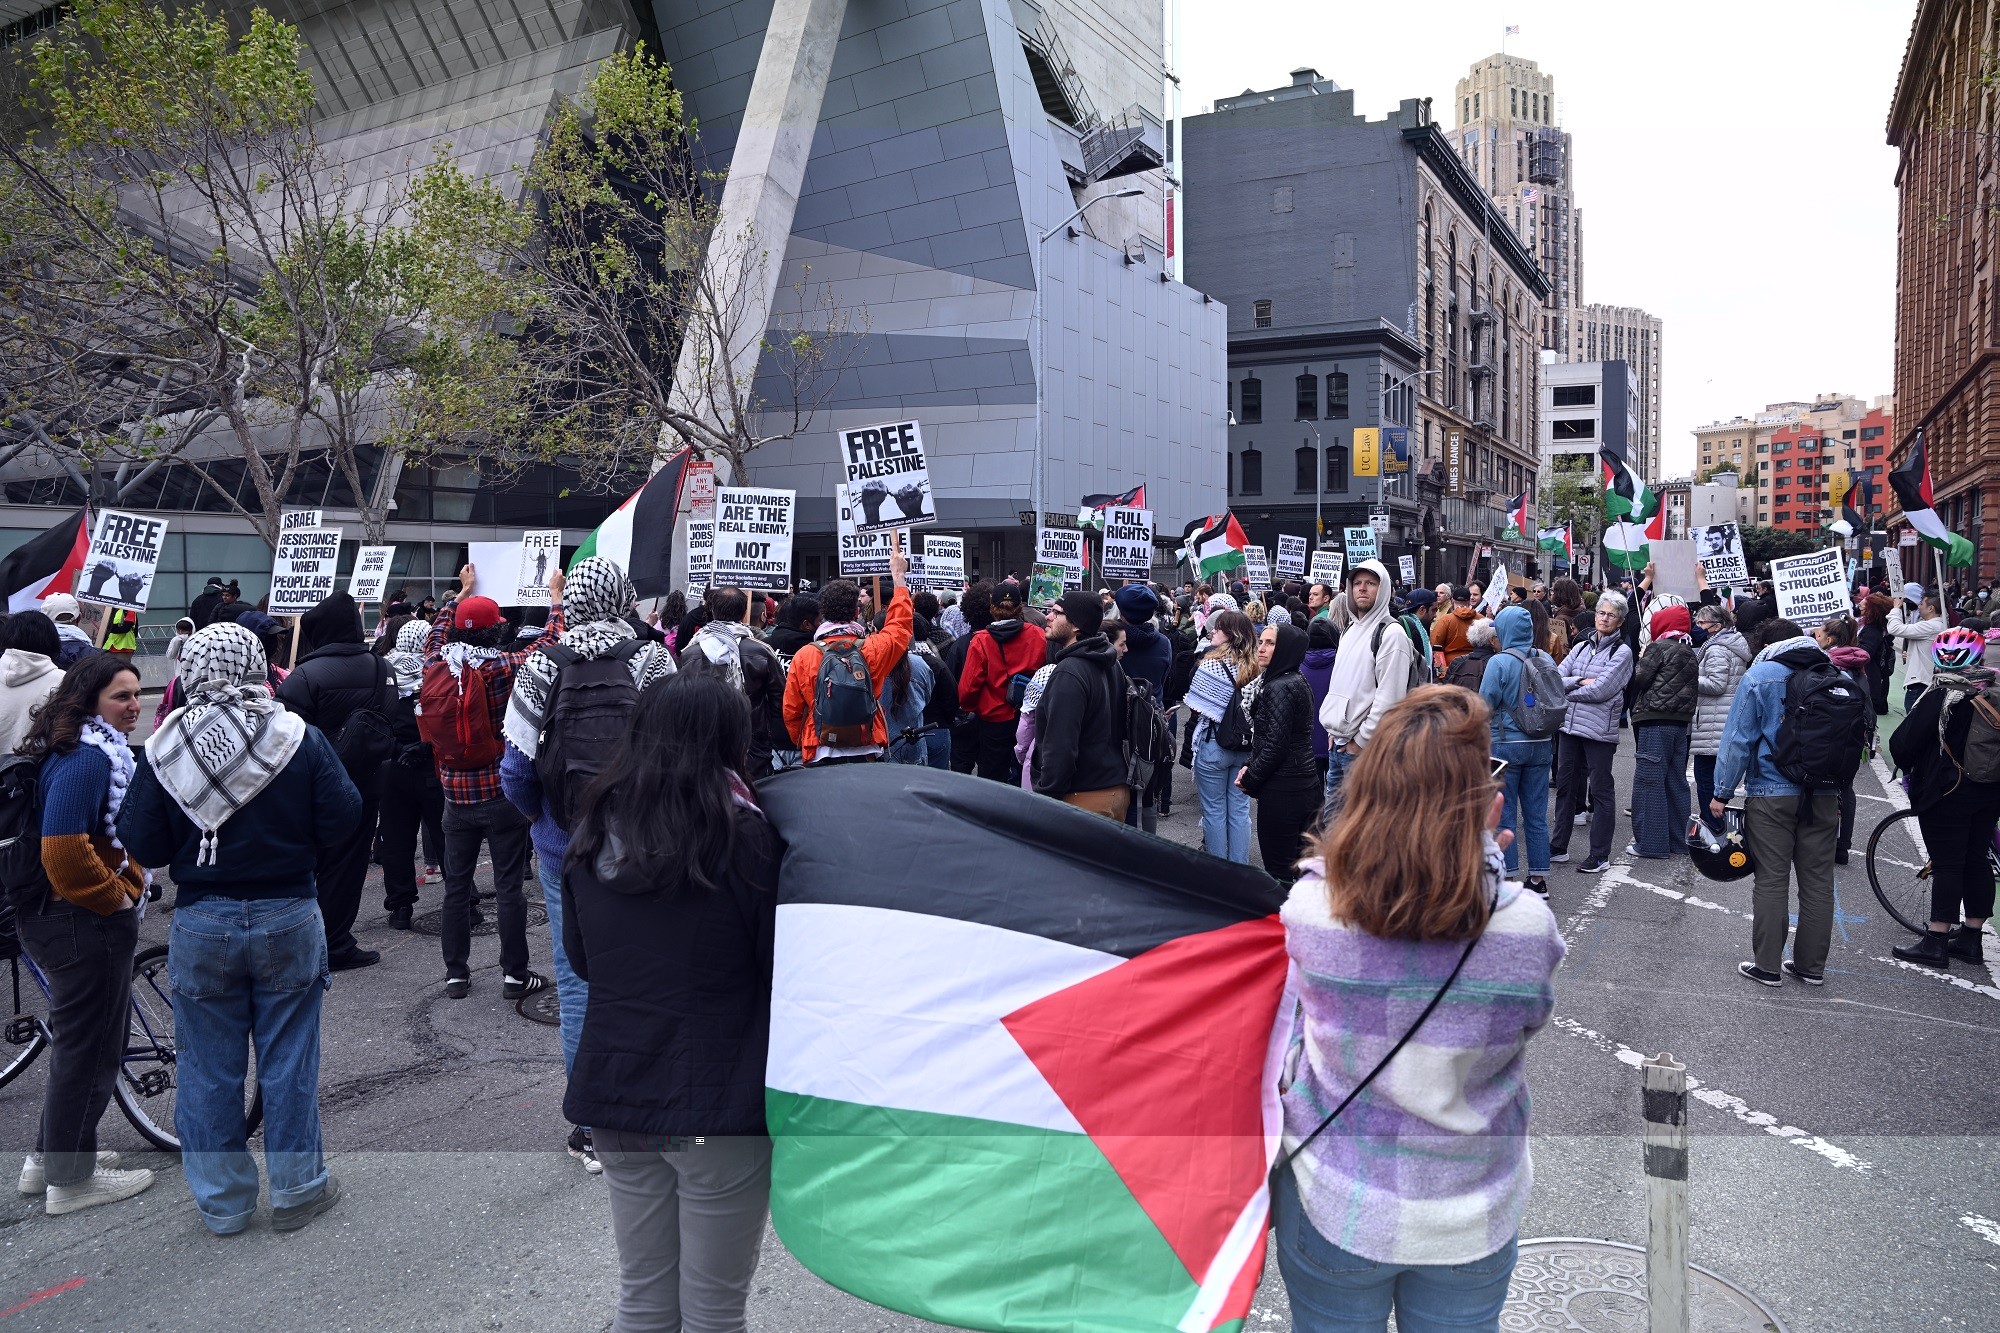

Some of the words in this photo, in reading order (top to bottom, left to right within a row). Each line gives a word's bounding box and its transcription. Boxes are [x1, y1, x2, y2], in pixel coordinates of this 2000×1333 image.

[846, 424, 918, 463] FREE
[1362, 434, 1370, 453] Law
[848, 454, 925, 481] PALESTINE
[1362, 457, 1370, 471] UC
[1450, 467, 1458, 491] LINES
[722, 494, 790, 506] BILLIONAIRES
[284, 512, 316, 528] ISRAEL
[723, 506, 754, 520] ARE
[758, 507, 787, 522] THE
[1115, 511, 1143, 526] FULL
[100, 514, 162, 549] FREE
[690, 531, 712, 540] JOBS
[719, 522, 746, 532] REAL
[749, 523, 789, 537] ENEMY,
[1054, 532, 1080, 540] PUEBLO
[1107, 525, 1149, 541] RIGHTS
[1350, 530, 1367, 539] END
[280, 534, 338, 545] RESISTANCE
[525, 536, 558, 547] FREE
[842, 534, 877, 548] STOP
[927, 540, 961, 548] ¡DERECHOS
[1044, 540, 1076, 552] UNIDO
[91, 540, 158, 564] PALESTINE
[278, 547, 288, 558] IS
[290, 547, 335, 559] JUSTIFIED
[736, 542, 770, 559] NOT
[843, 547, 906, 558] DEPORTATIOS!
[927, 548, 961, 558] PLENOS
[1106, 545, 1126, 558] FOR
[1130, 546, 1148, 559] ALL
[690, 555, 707, 563] NOT
[1105, 558, 1148, 566] IMMIGRANTS!
[1700, 556, 1740, 569] RELEASE
[1784, 554, 1830, 568] SOLIDARITY!
[292, 561, 319, 572] WHEN
[717, 560, 786, 572] IMMIGRANTS!
[1313, 563, 1340, 571] GENOCIDE
[1789, 562, 1838, 578] WORKERS'
[274, 576, 311, 588] PEOPLE
[312, 576, 332, 588] ARE
[1780, 572, 1841, 591] STRUGGLE
[275, 590, 327, 602] OCCUPIED!
[518, 589, 551, 597] PALESTIN
[1792, 594, 1815, 604] HAS
[1818, 590, 1834, 601] NO
[1785, 599, 1843, 616] BORDERS!
